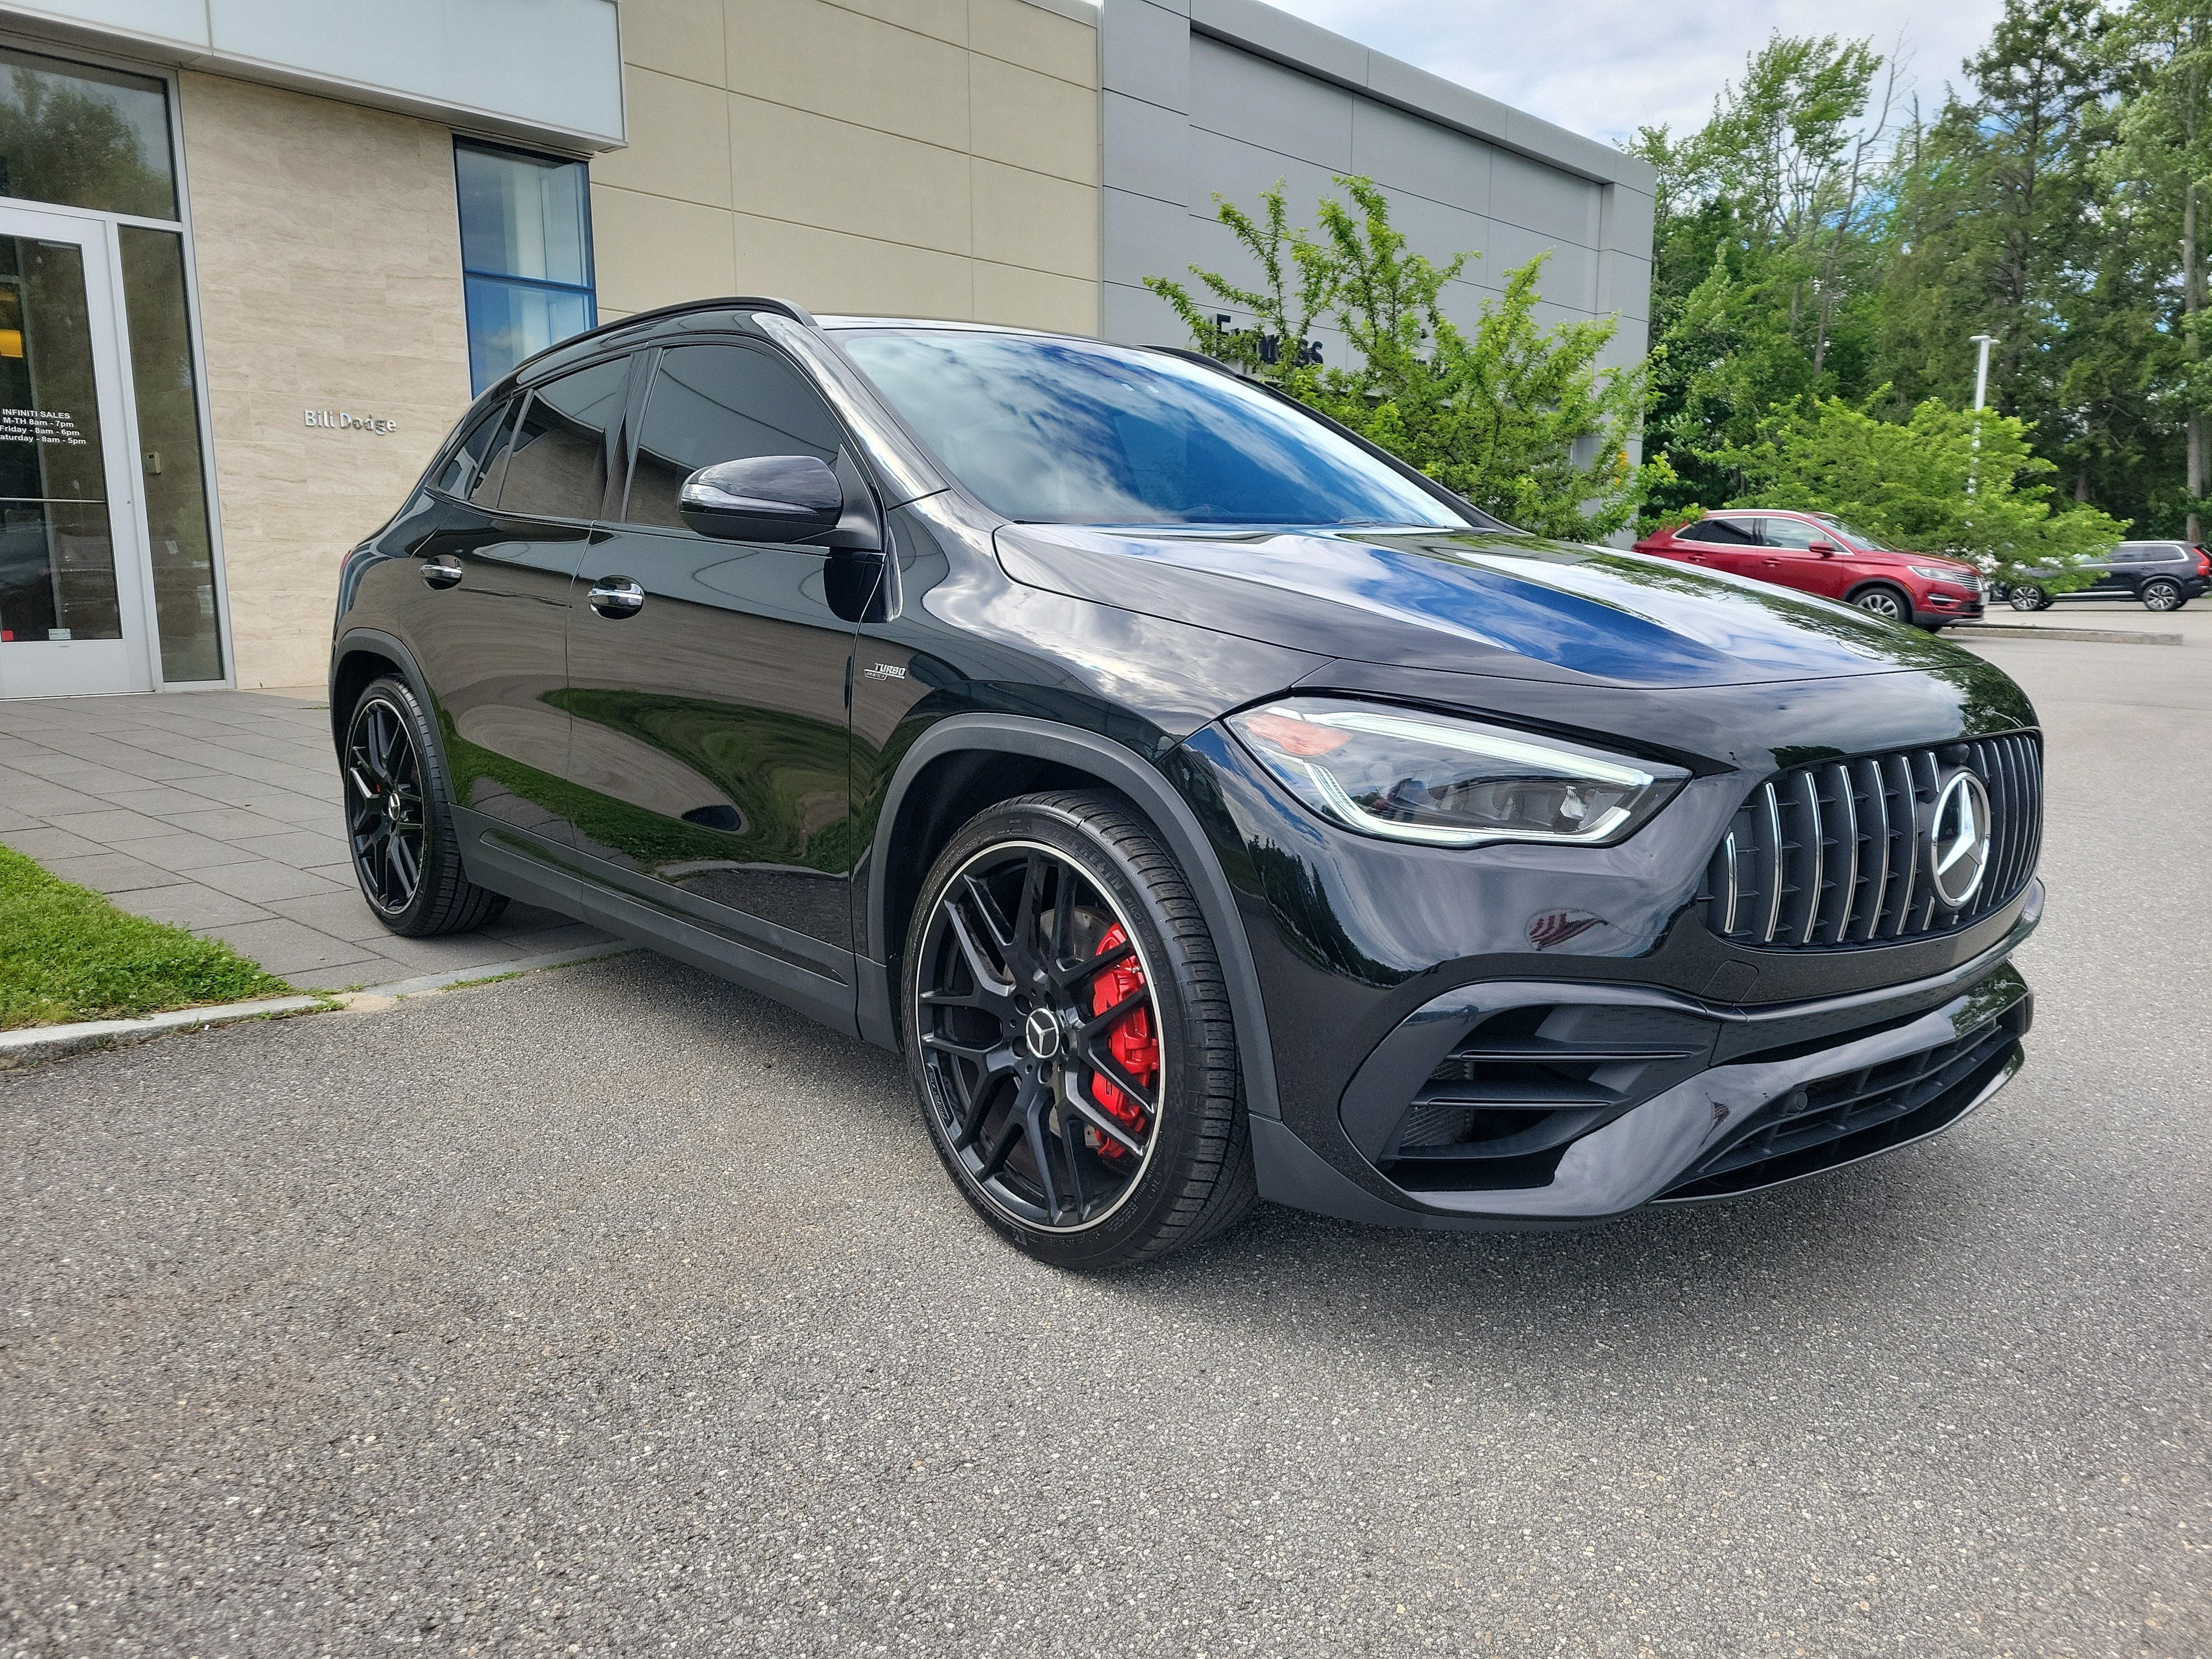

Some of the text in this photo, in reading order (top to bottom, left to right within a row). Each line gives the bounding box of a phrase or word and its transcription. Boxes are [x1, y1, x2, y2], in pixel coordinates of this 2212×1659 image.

[2, 408, 71, 419] INFINITI SALES
[304, 409, 397, 435] Bill Dodge
[0, 425, 26, 434] Friday
[0, 434, 33, 443] aturday
[874, 663, 906, 676] TURBO
